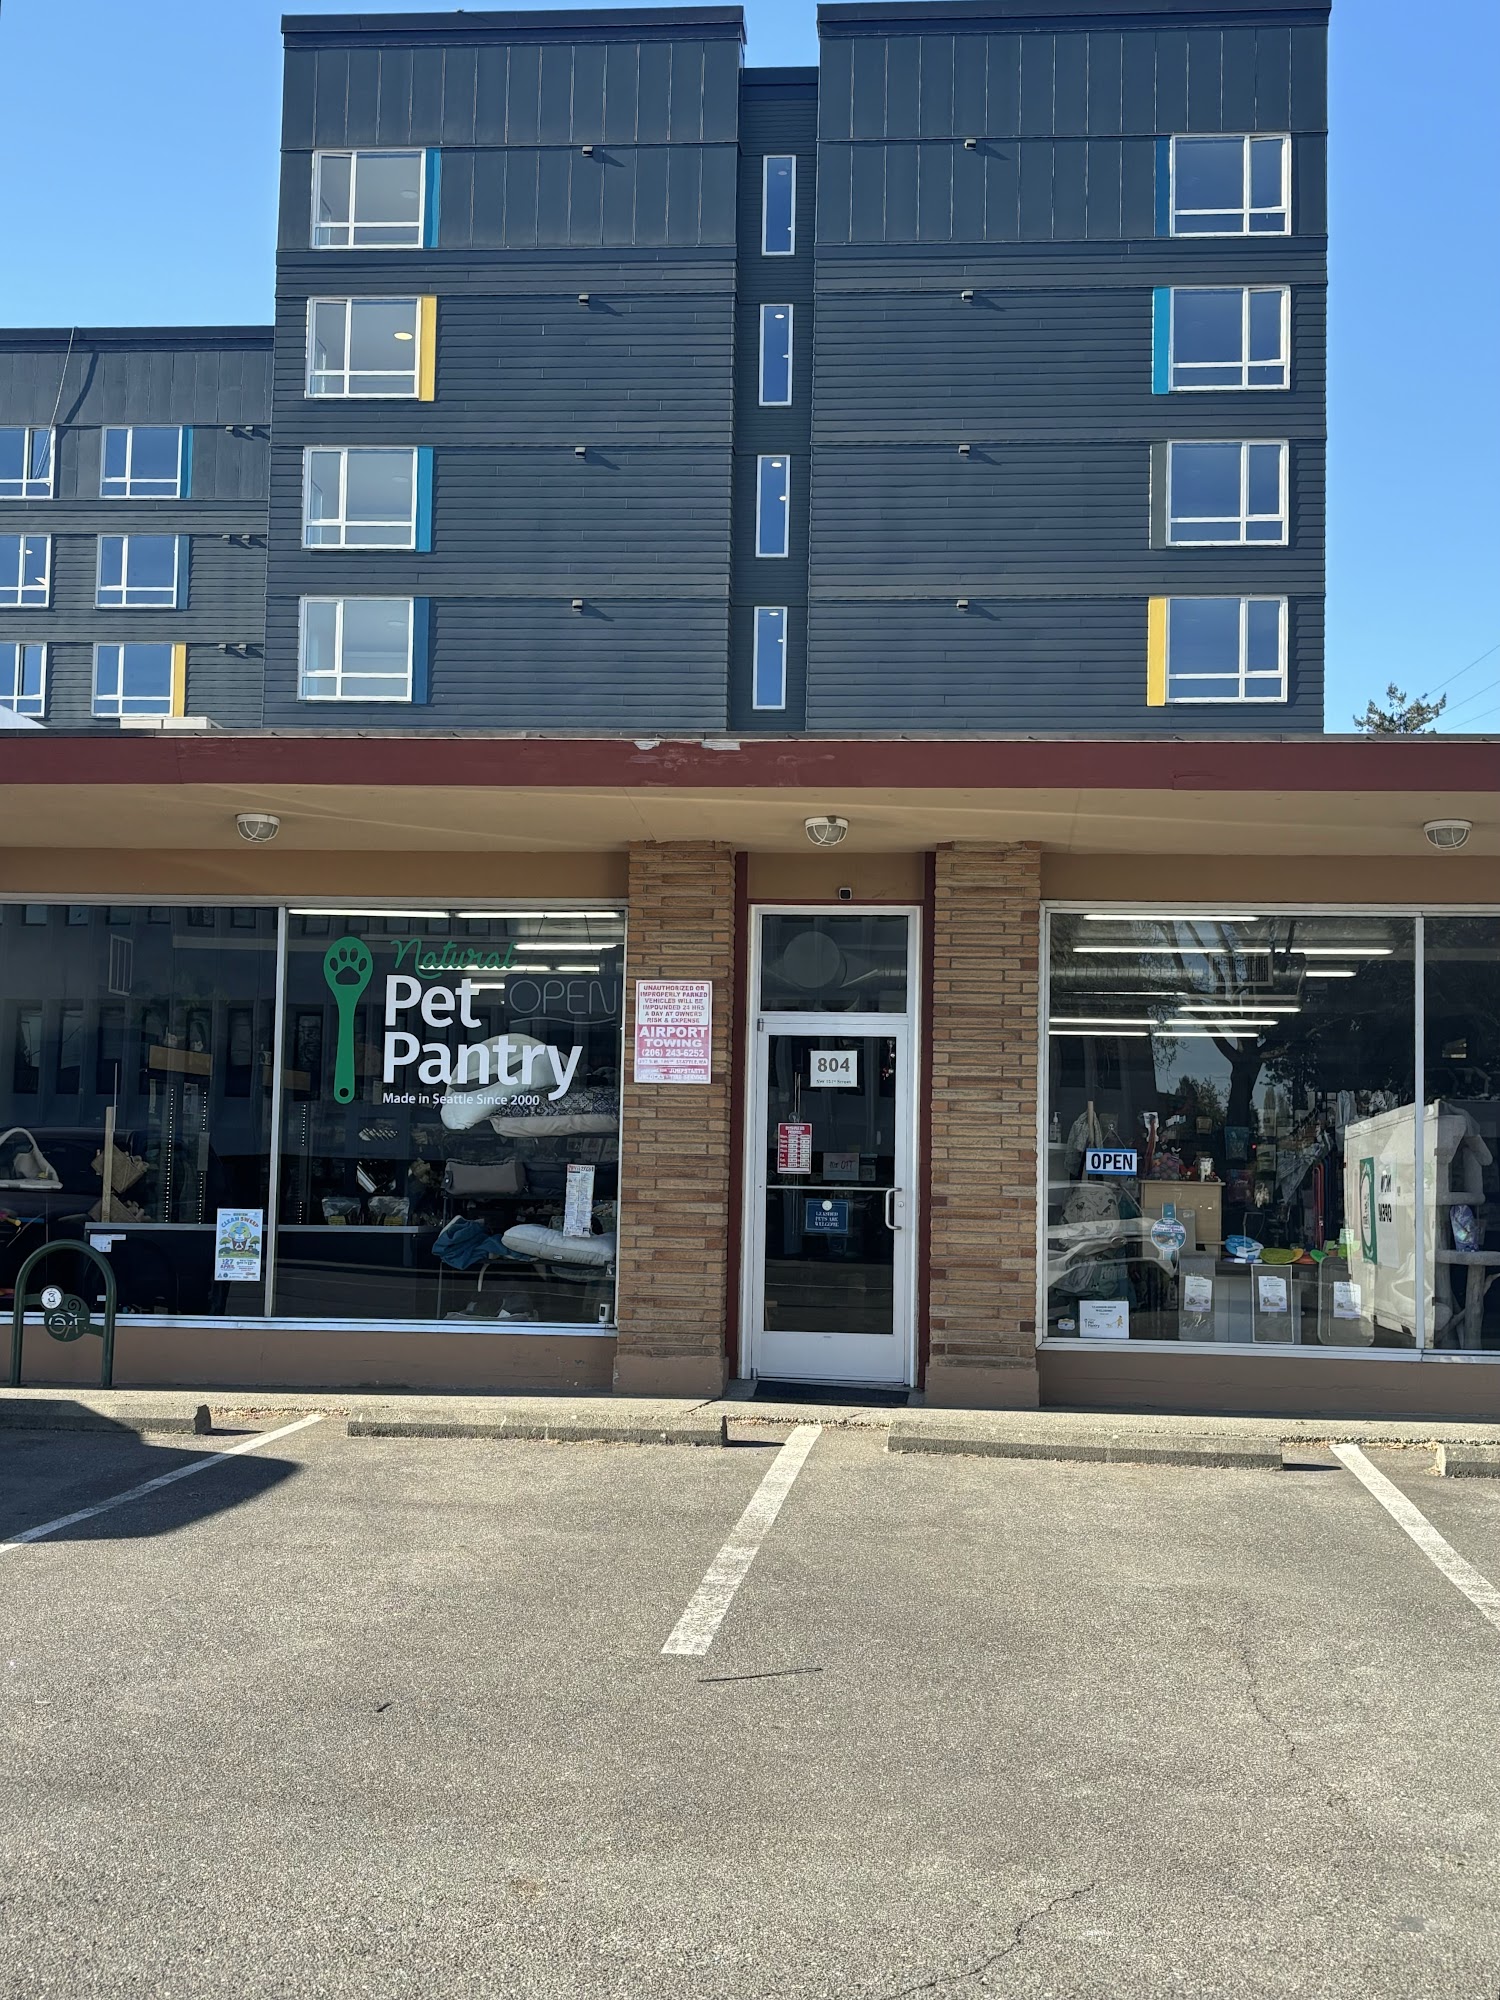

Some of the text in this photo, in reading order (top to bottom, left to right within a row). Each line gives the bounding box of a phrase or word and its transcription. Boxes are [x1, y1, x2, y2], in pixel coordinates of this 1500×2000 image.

[390, 938, 517, 979] Natural
[385, 974, 482, 1028] Pet
[509, 980, 616, 1014] OPEN
[639, 1026, 707, 1038] AIRPORT
[644, 1039, 702, 1047] TOWING
[642, 1048, 704, 1057] (206) 243-6252
[383, 1032, 582, 1100] Pantry
[818, 1058, 849, 1072] 804
[383, 1093, 540, 1106] Made in Seattle Since 2000
[1091, 1154, 1132, 1170] OPEN
[221, 1216, 259, 1228] CLEAN SWEEP
